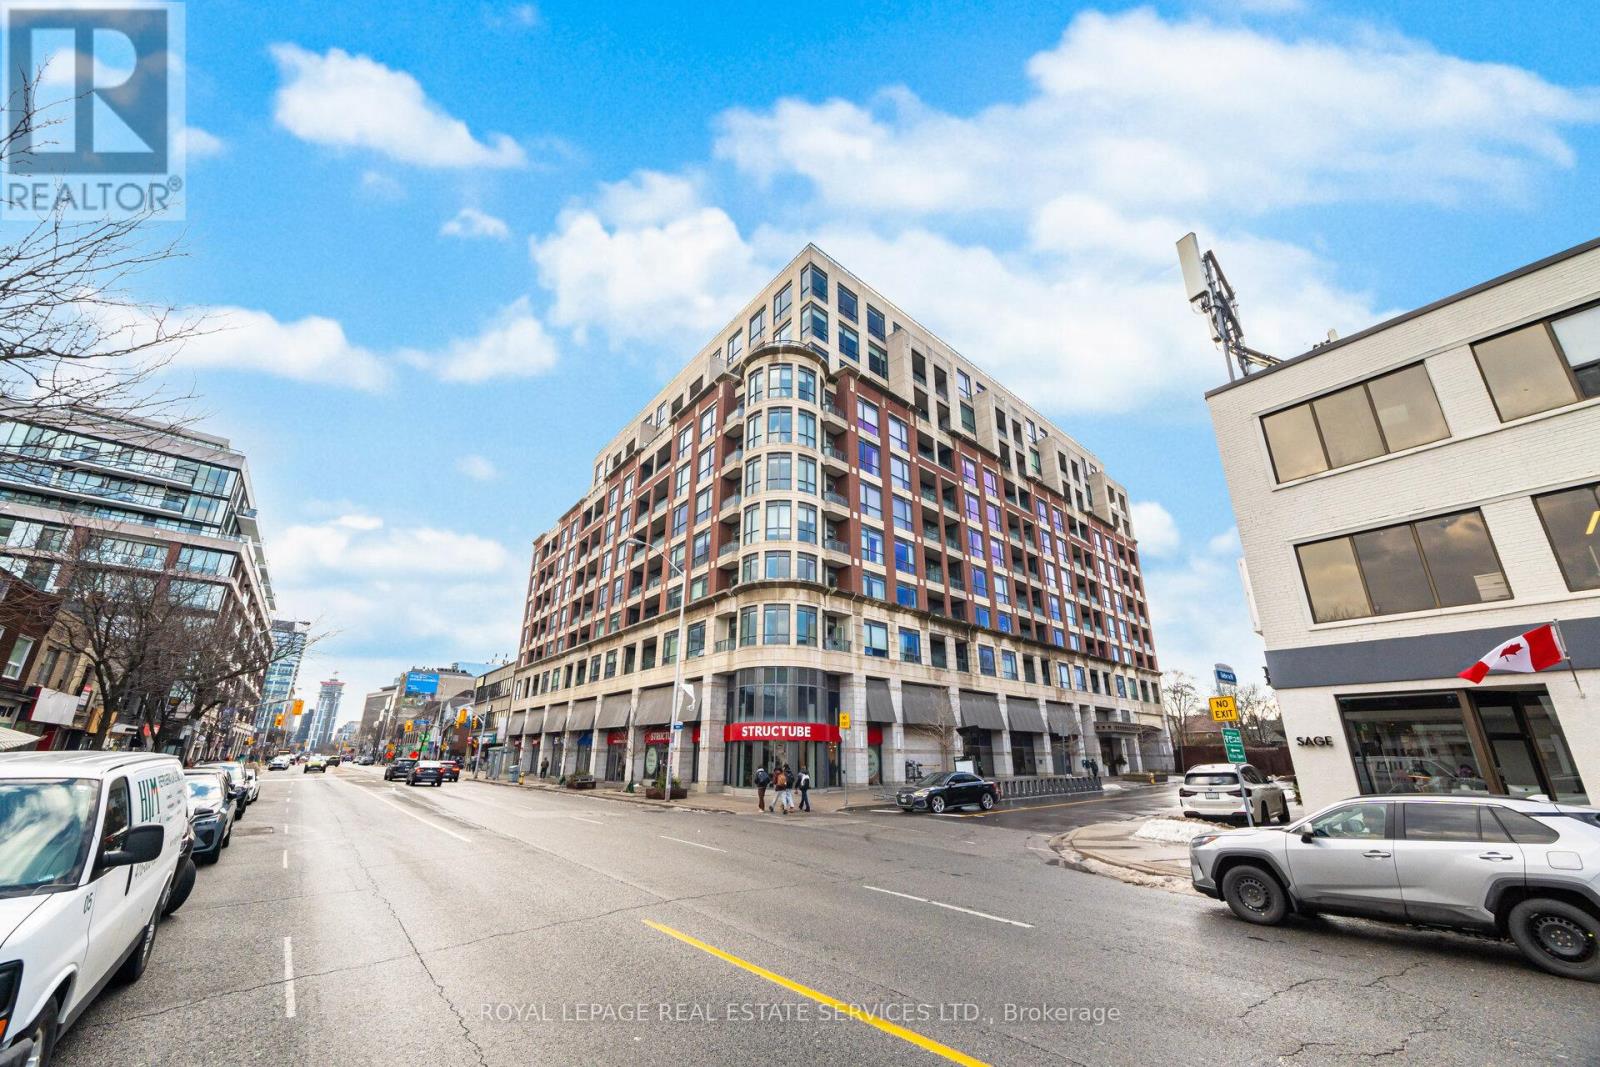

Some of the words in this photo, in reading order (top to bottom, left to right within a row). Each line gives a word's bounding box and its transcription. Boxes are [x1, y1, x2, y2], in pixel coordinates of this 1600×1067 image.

[1216, 700, 1229, 708] NO
[1215, 710, 1233, 719] EXIT
[742, 725, 811, 738] STRUCTUBE
[1296, 736, 1333, 747] SAGE
